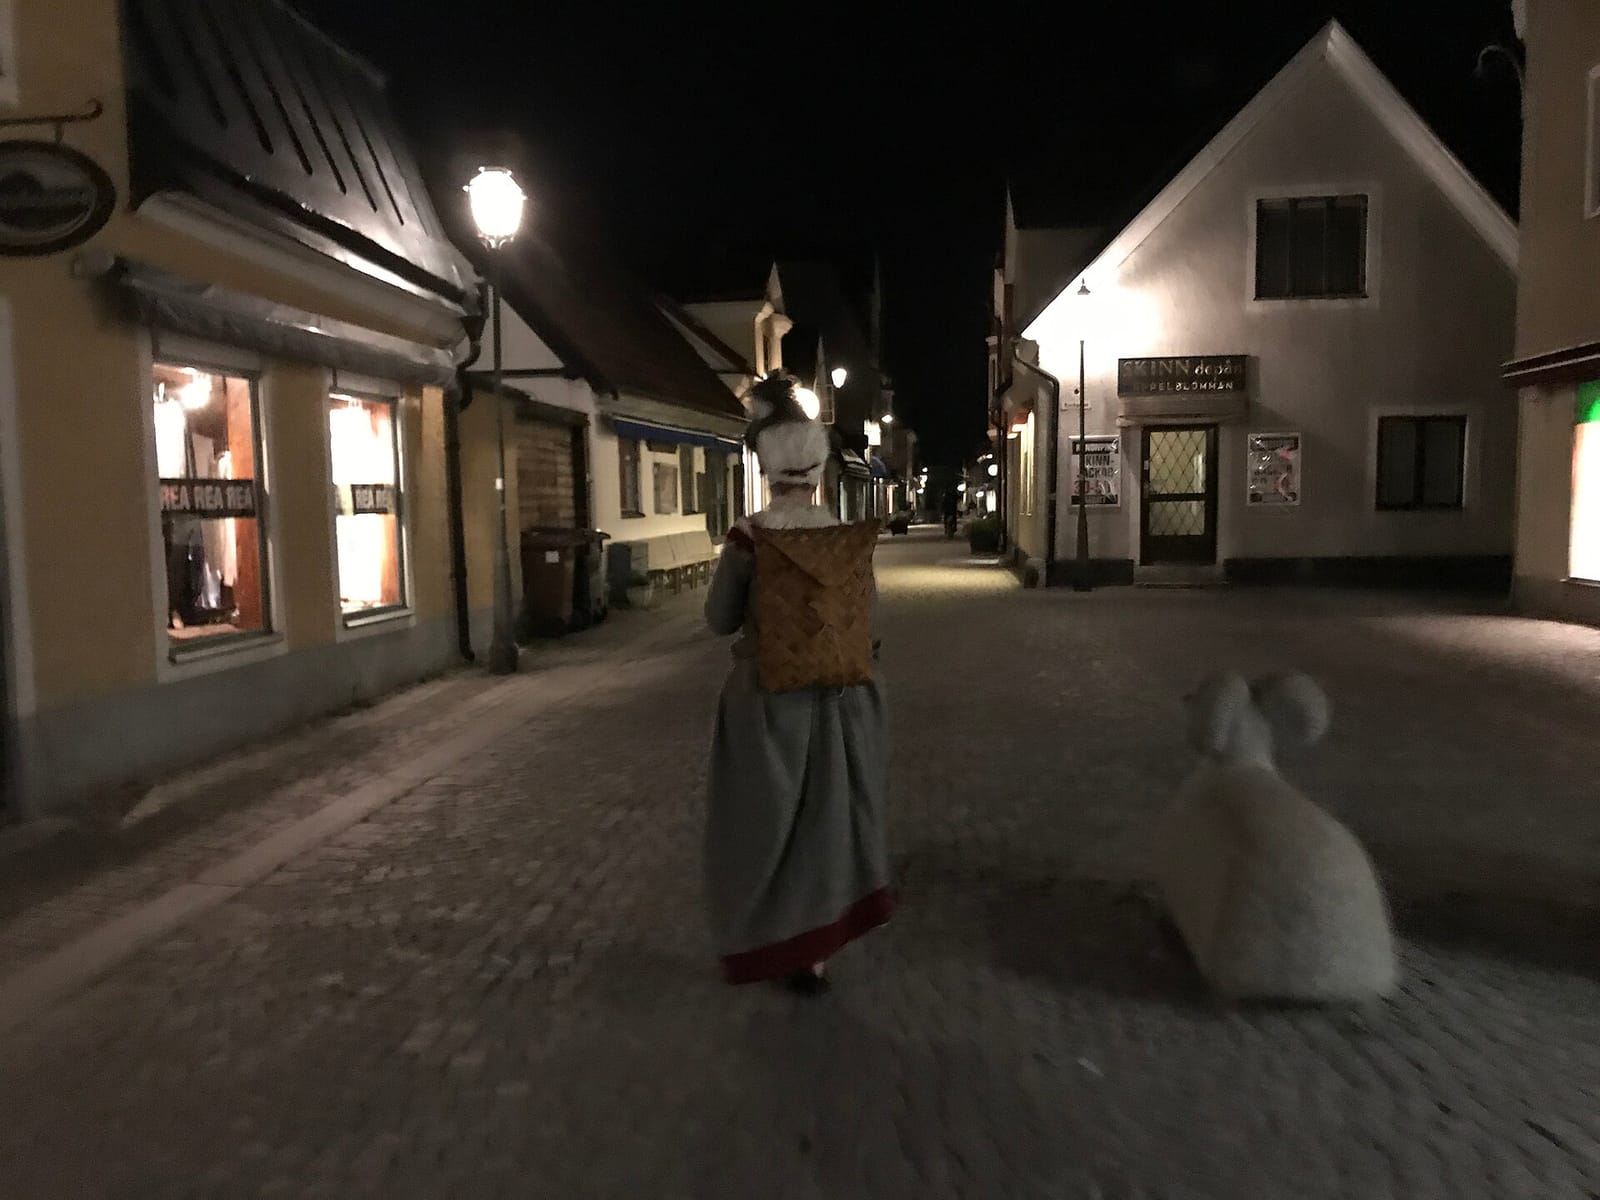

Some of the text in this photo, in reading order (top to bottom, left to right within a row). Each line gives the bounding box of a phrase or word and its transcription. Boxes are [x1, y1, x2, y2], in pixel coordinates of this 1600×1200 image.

[160, 485, 253, 510] REA REA REA
